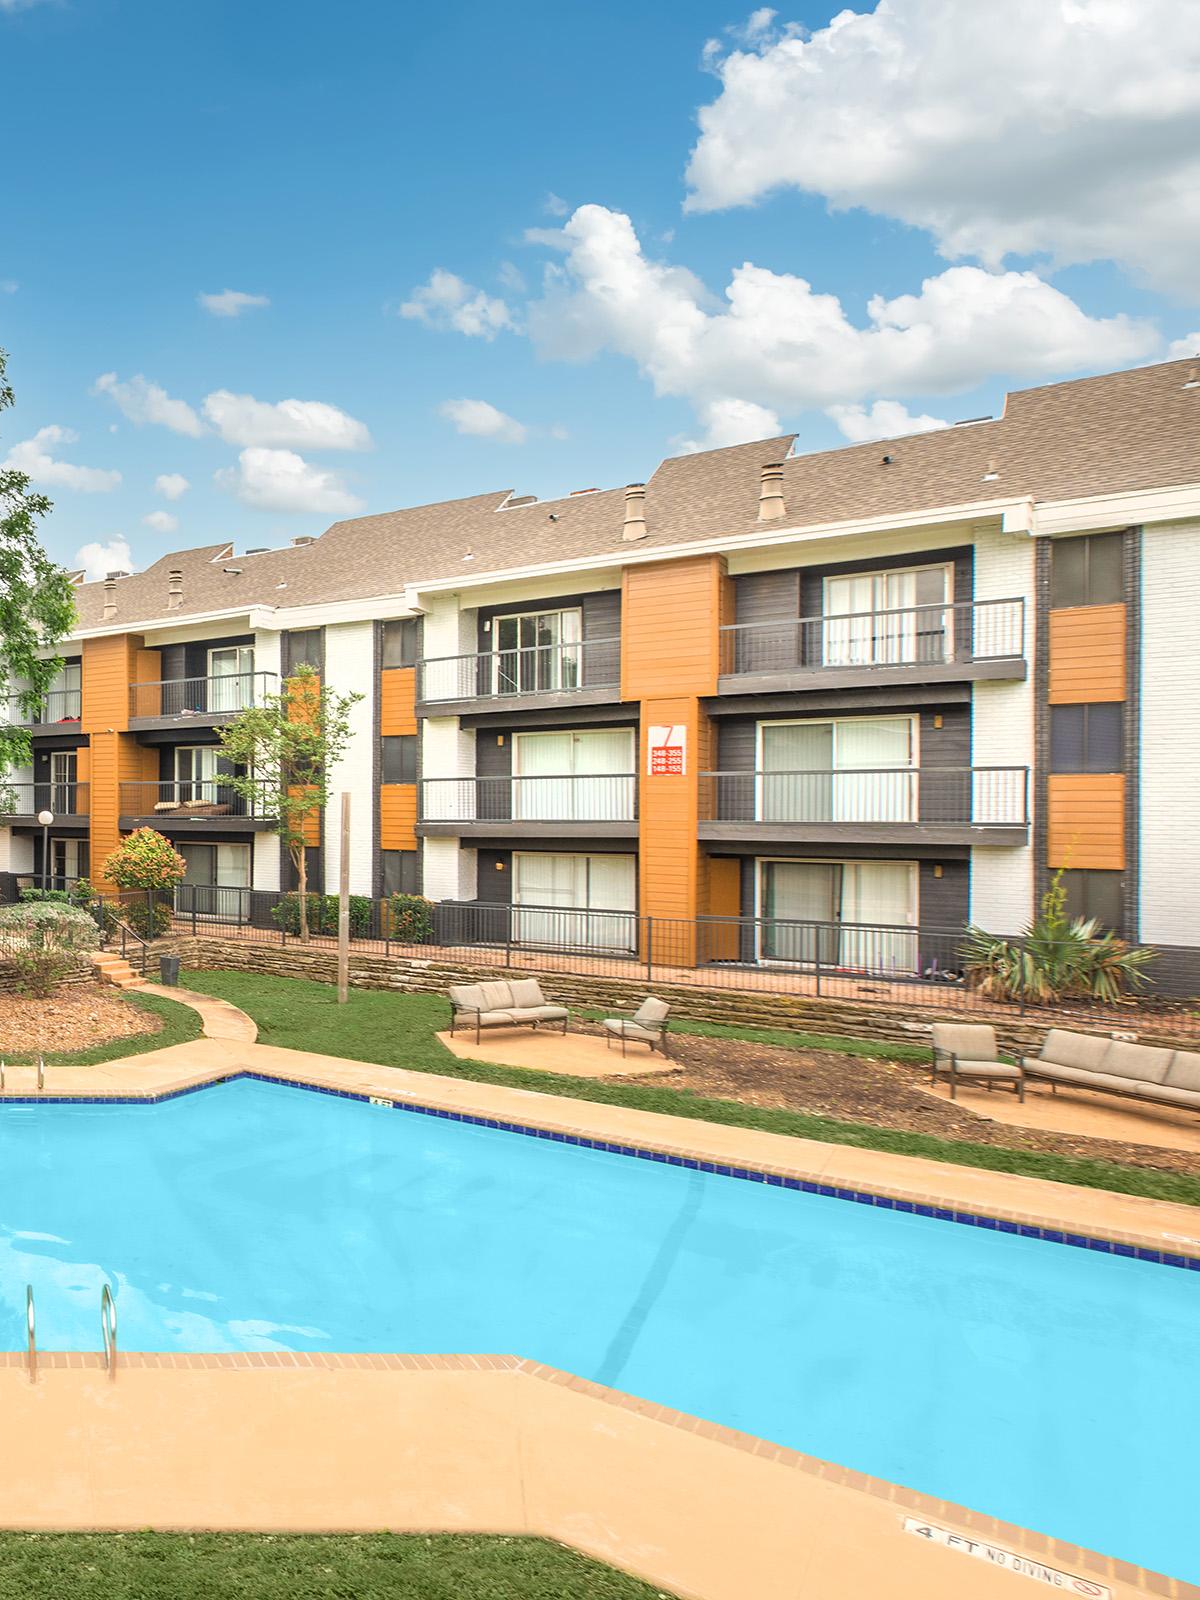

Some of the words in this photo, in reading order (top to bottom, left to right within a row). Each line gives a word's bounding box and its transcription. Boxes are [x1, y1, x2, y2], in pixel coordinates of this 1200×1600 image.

[661, 726, 674, 747] 7
[915, 1527, 933, 1539] 4
[947, 1535, 979, 1553] FT
[985, 1548, 1006, 1565] NO
[1013, 1558, 1063, 1586] DIVING
